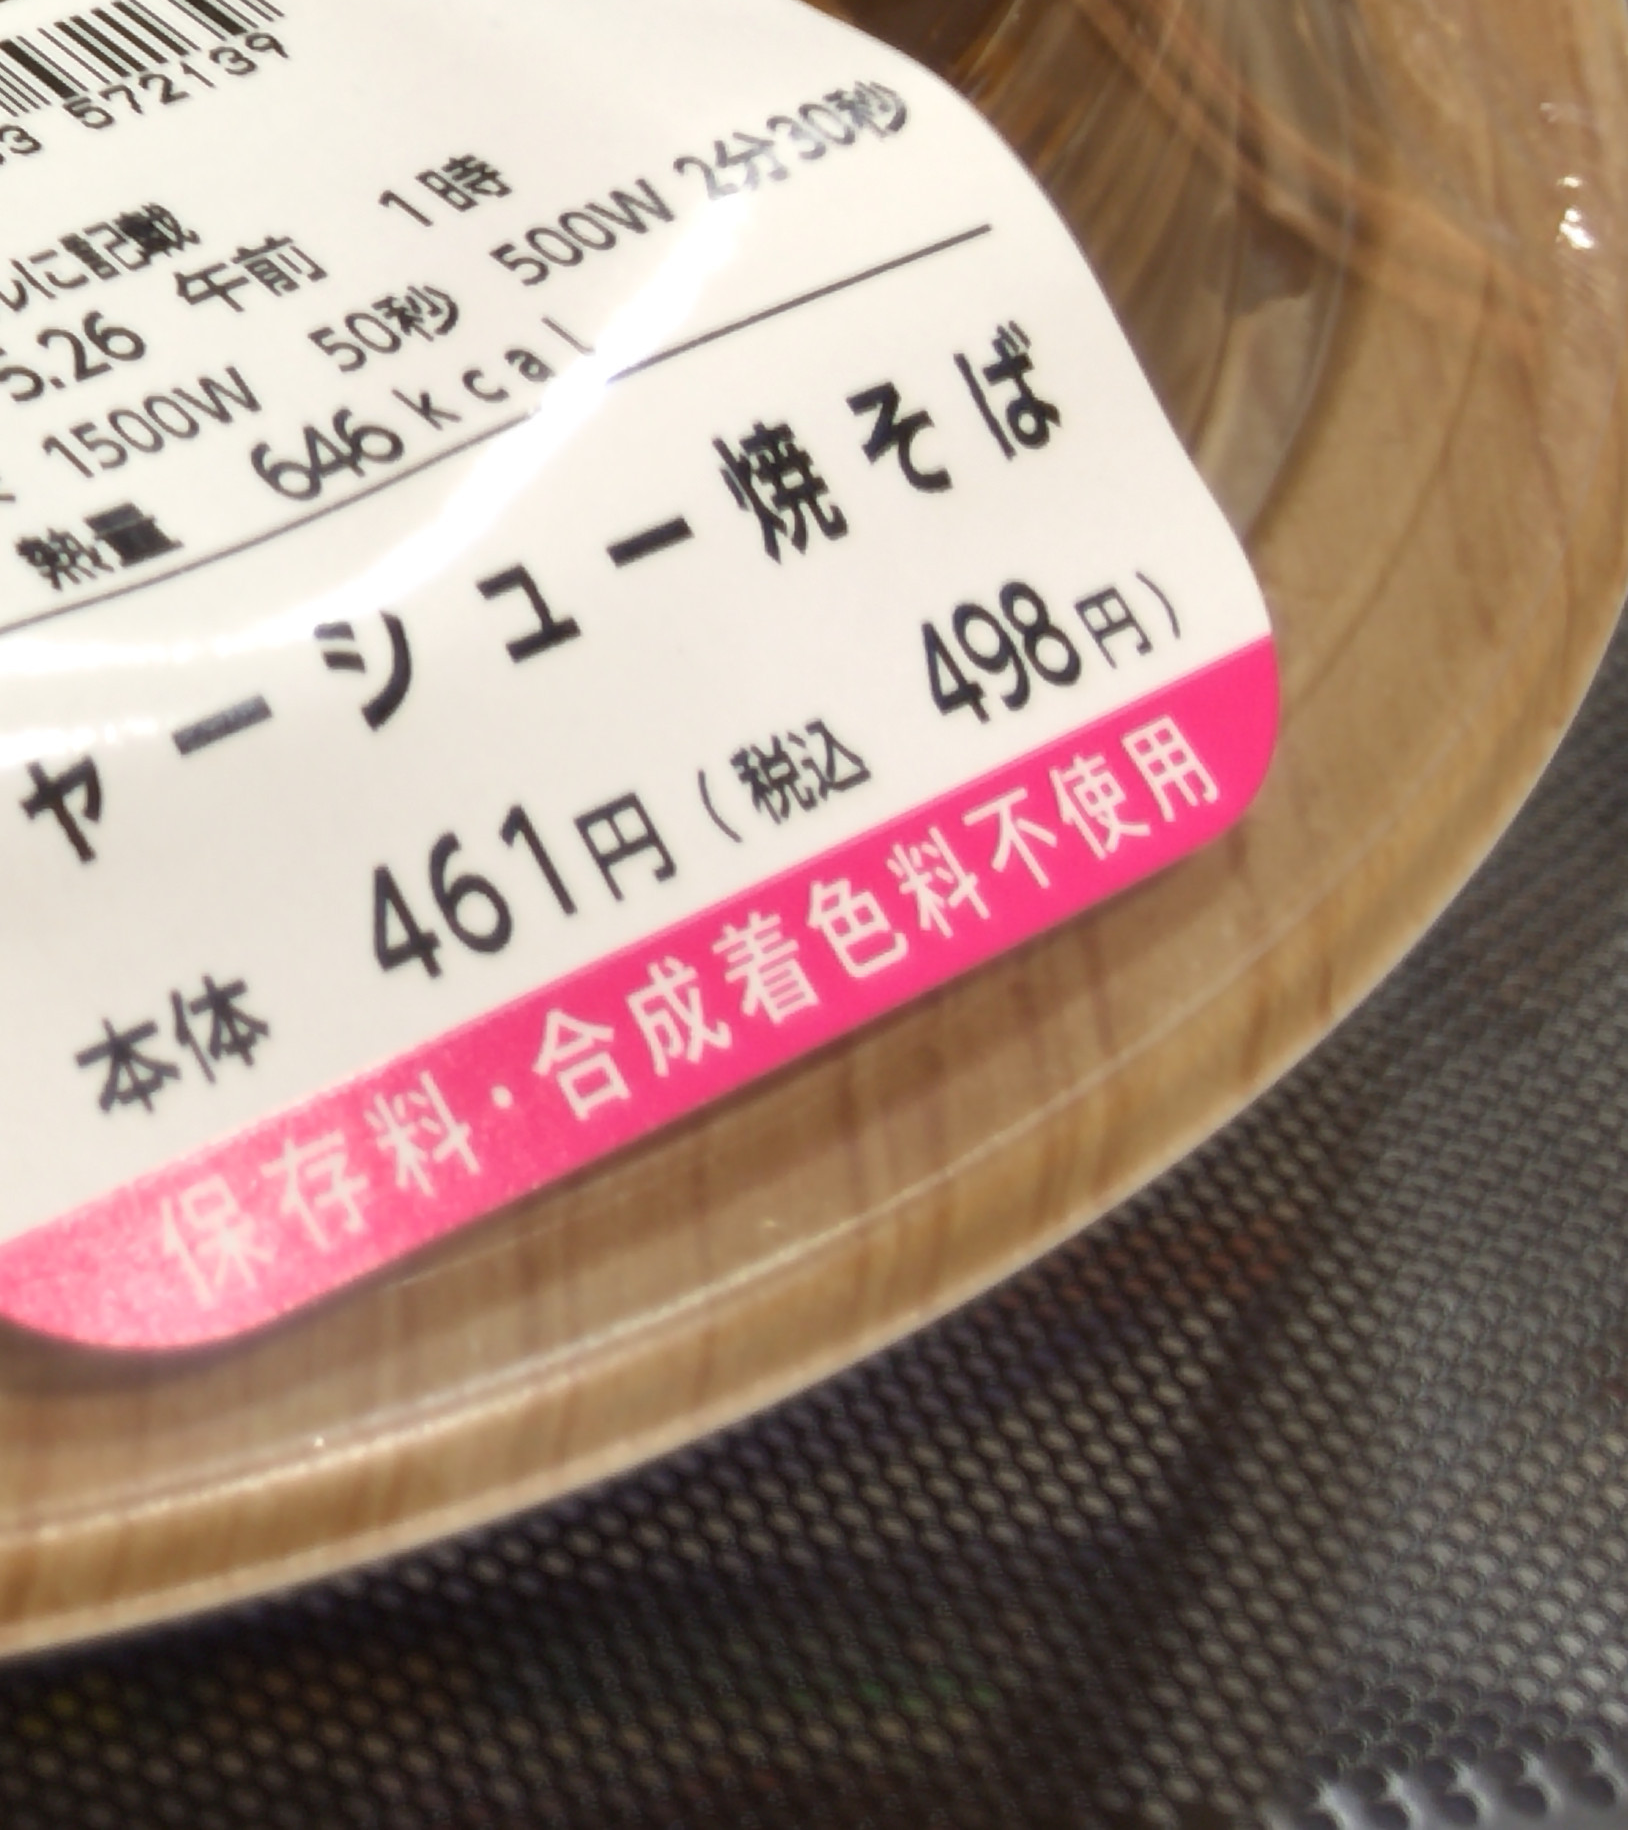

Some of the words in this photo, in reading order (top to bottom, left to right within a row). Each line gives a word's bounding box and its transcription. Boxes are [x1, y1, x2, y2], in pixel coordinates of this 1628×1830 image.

[61, 31, 290, 132] 572139
[42, 364, 264, 481] 1500W
[307, 283, 461, 374] 50秒
[489, 175, 676, 289] 500W
[673, 78, 911, 202] 2分30秒
[174, 232, 328, 316] 午前
[13, 501, 186, 592] 熱量
[249, 406, 407, 504] 646
[72, 972, 273, 1118] 本体
[368, 793, 676, 981] 461円
[156, 712, 1226, 1312] 保存料・合成着色料不使用
